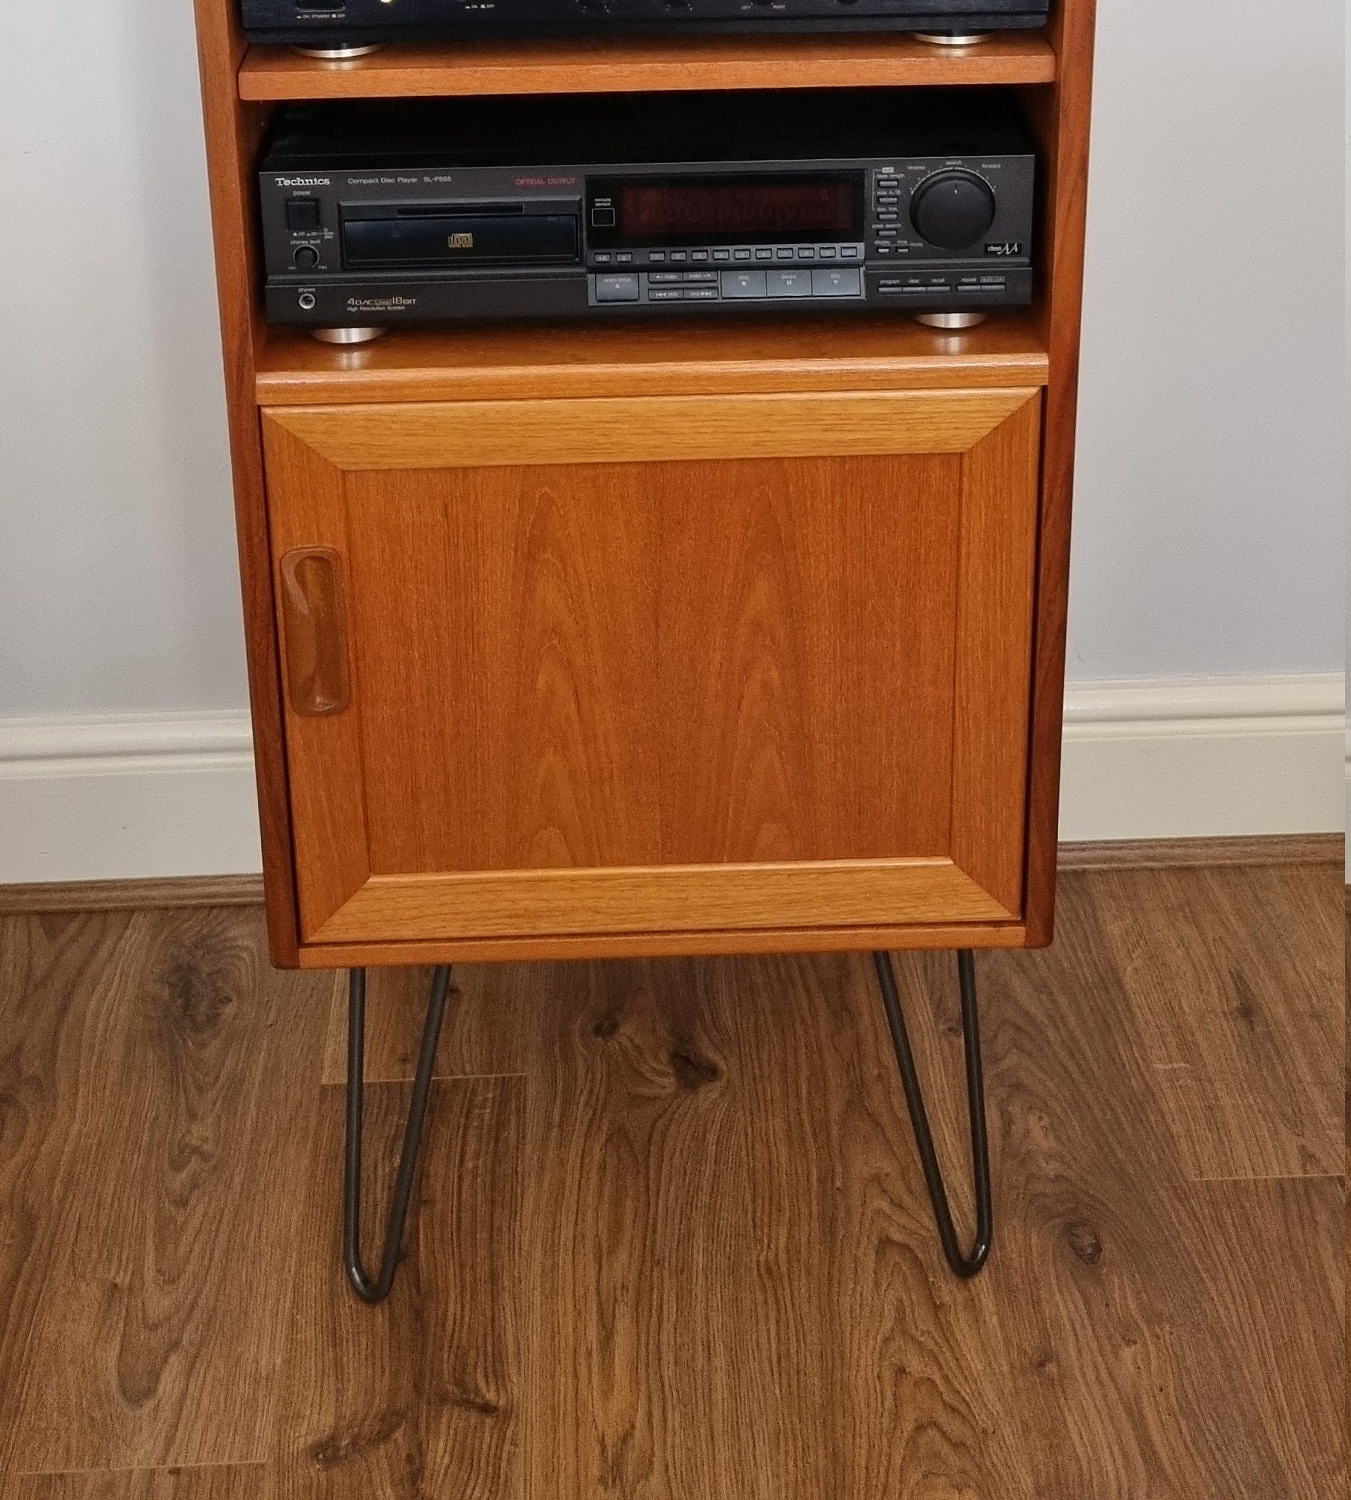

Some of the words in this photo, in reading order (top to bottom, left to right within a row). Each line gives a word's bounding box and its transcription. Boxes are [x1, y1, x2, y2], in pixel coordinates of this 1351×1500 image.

[275, 178, 330, 186] Technics
[348, 178, 378, 186] Compact
[398, 176, 418, 184] Player
[516, 178, 545, 186] OPTICAL
